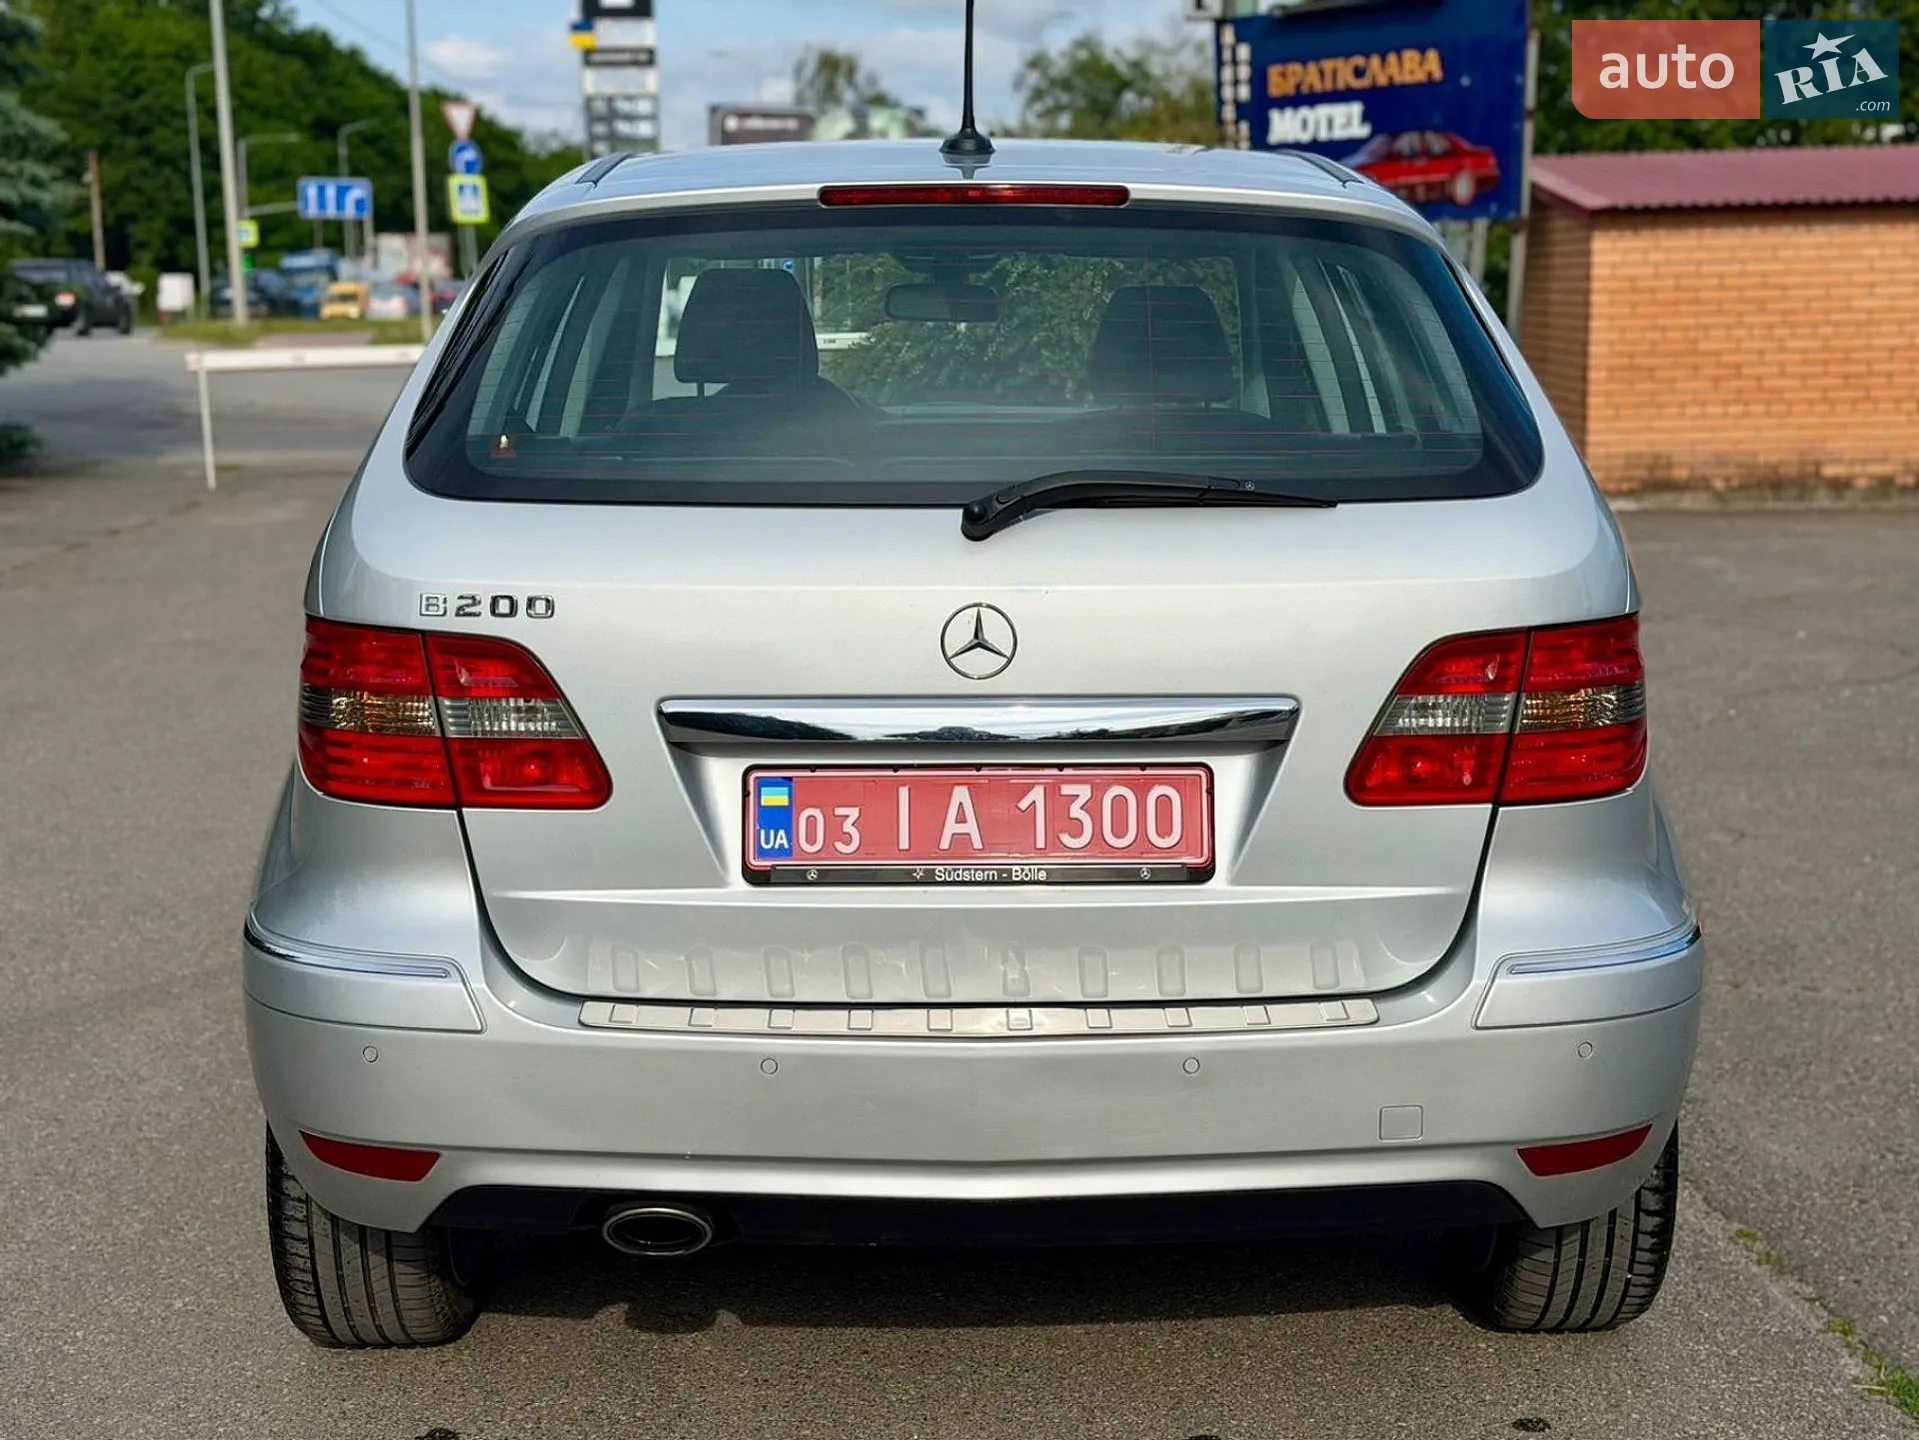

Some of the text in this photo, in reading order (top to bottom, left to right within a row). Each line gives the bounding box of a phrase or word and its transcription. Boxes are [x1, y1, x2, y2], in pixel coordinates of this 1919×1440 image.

[1266, 47, 1443, 97] БРАТІСЛАВА
[1266, 101, 1372, 145] MOTEL
[760, 829, 789, 849] UA
[798, 806, 861, 854] 03
[1016, 784, 1184, 849] 1300
[934, 866, 998, 881] Südstern
[1011, 866, 1047, 881] Bölle
